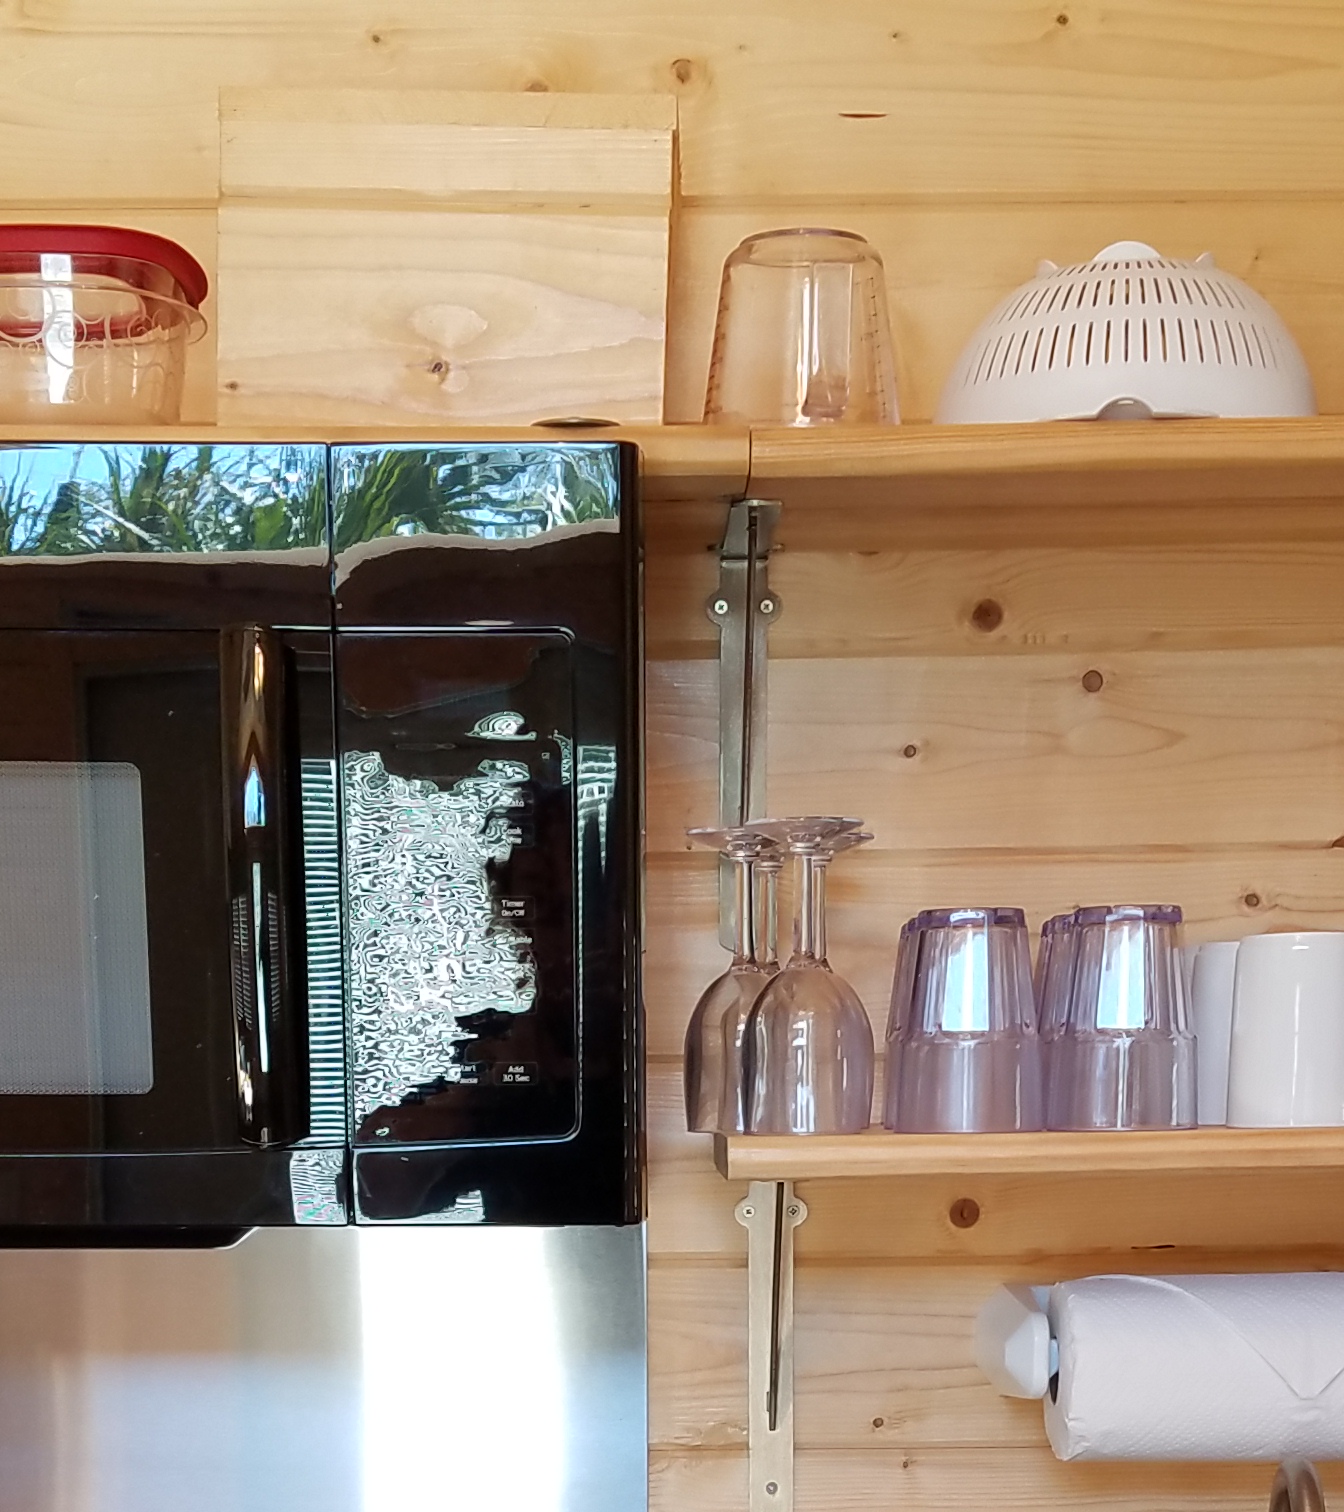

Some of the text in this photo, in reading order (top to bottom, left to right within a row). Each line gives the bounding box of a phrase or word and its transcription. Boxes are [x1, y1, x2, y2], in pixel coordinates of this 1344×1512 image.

[501, 900, 525, 908] Timer
[508, 1065, 524, 1073] Add
[502, 1074, 531, 1082] 30 Sec
